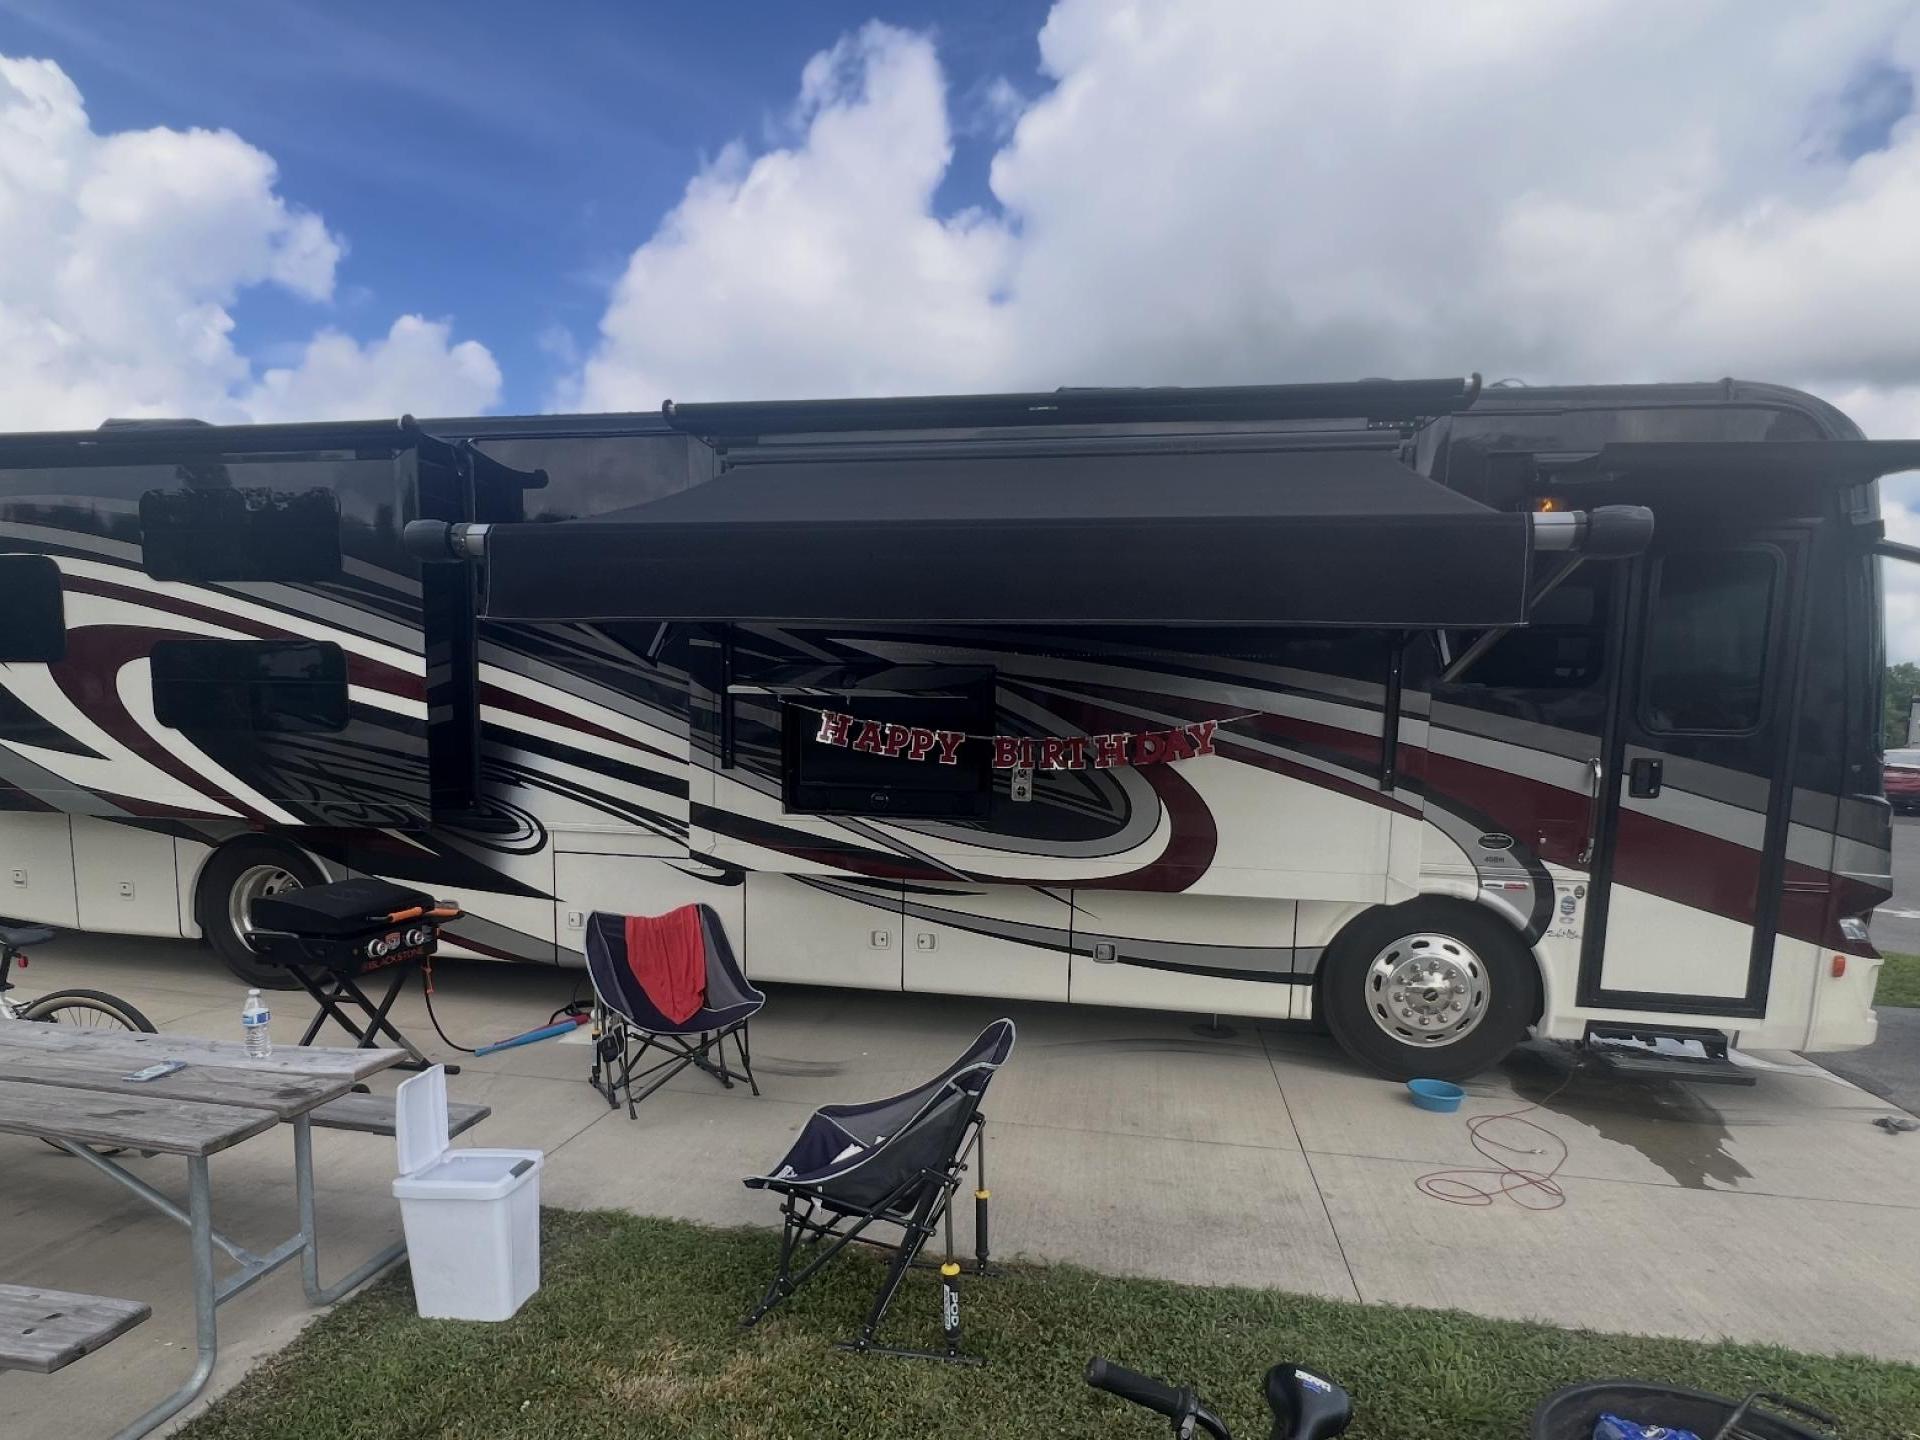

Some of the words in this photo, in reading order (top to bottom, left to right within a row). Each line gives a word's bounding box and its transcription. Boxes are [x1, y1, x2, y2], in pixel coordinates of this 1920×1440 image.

[816, 710, 966, 765] HAPPY
[992, 720, 1218, 770] BIRTHDAY
[950, 1291, 959, 1326] POD
